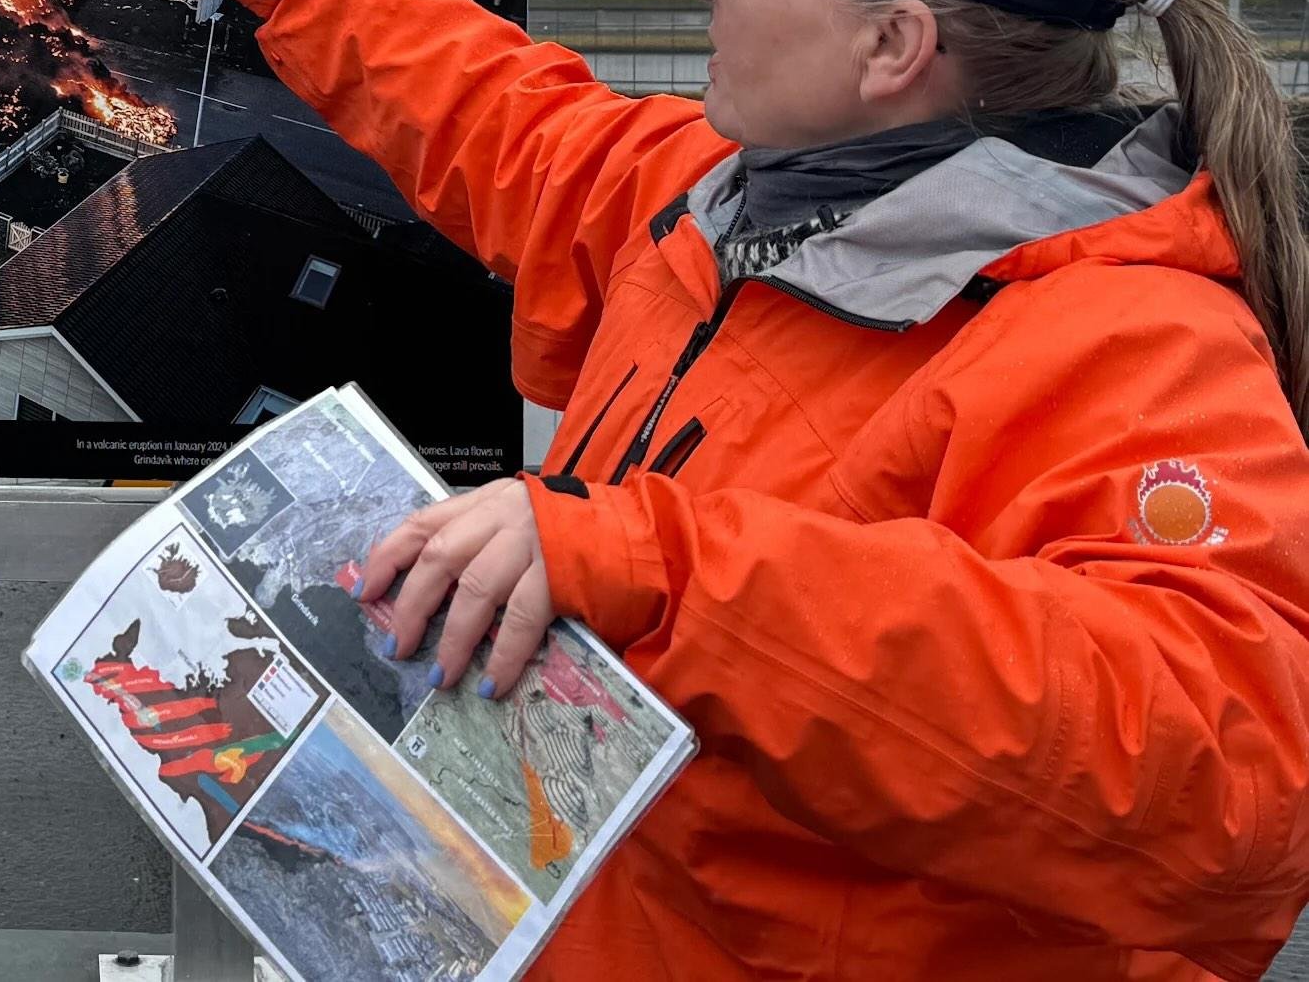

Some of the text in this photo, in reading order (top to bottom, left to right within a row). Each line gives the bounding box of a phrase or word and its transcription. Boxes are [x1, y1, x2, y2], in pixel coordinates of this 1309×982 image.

[76, 439, 84, 449] In
[93, 440, 127, 450] volcanic
[128, 441, 163, 452] eruption
[165, 442, 172, 450] in
[174, 441, 206, 453] January
[450, 446, 469, 456] Lava
[471, 446, 493, 457] flows
[495, 447, 503, 457] in
[174, 455, 199, 465] where
[453, 460, 468, 471] still
[469, 460, 503, 472] prevails.
